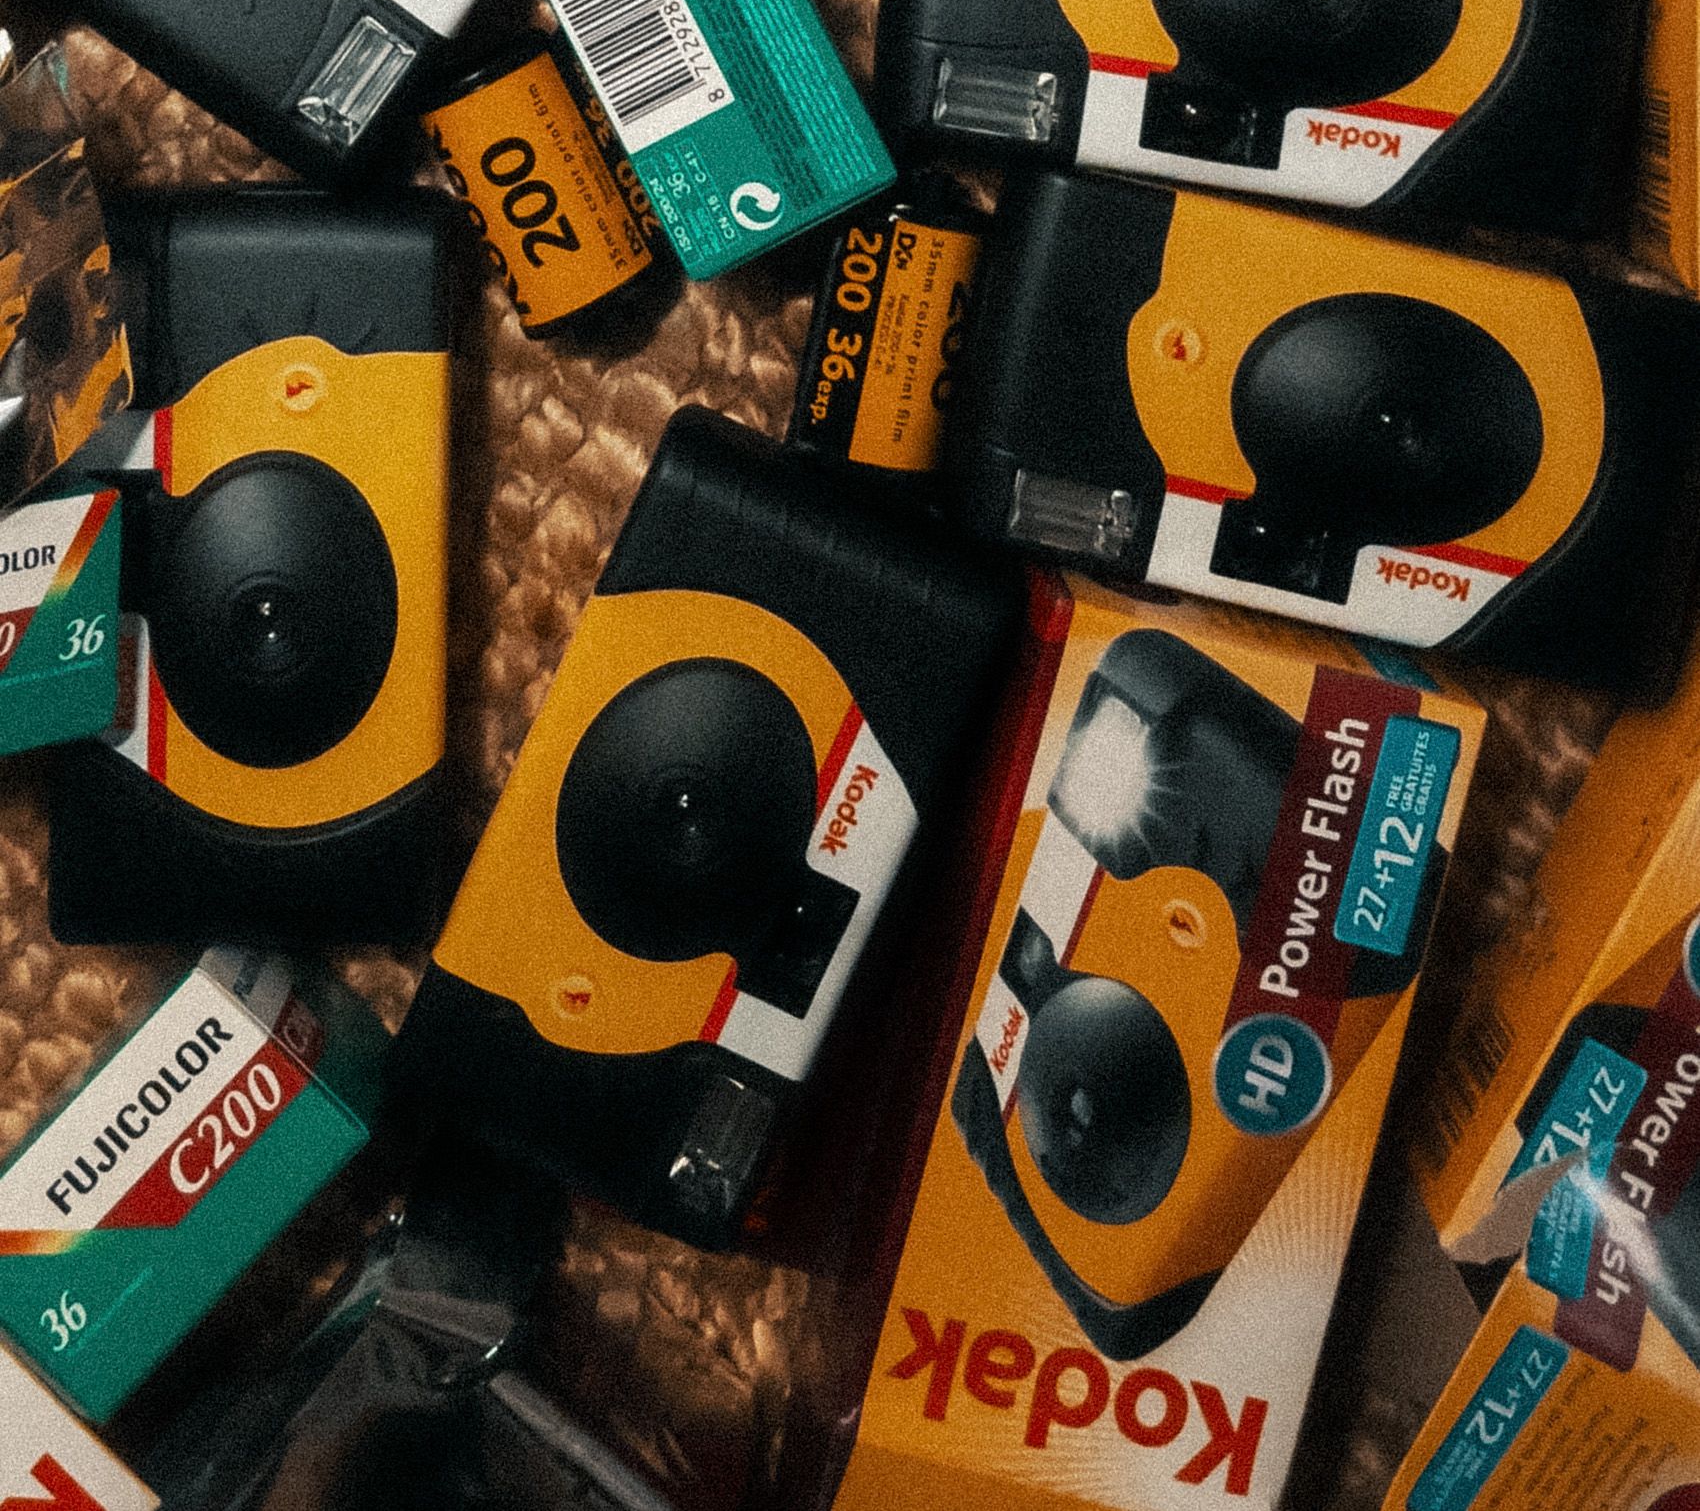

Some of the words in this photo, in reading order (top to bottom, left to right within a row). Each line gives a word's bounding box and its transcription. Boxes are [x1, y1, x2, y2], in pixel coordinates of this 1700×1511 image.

[522, 82, 549, 118] film
[706, 88, 726, 104] 8
[543, 120, 575, 164] print
[1307, 115, 1402, 159] Kodak
[480, 136, 583, 267] 200
[566, 167, 598, 215] color
[664, 169, 693, 200] 36
[591, 215, 627, 271] 35mm
[671, 223, 694, 253] ISO
[921, 237, 944, 294] 35mm
[836, 227, 883, 312] 200
[910, 300, 931, 349] color
[897, 354, 919, 401] print
[891, 408, 911, 444] film
[1376, 555, 1472, 602] Kodak
[54, 613, 110, 661] 36
[1384, 773, 1404, 808] FREE
[1397, 730, 1432, 812] GRATUITES
[1412, 762, 1438, 816] GRATIS
[819, 764, 880, 858] Kodak
[1259, 850, 1332, 999] Power
[1301, 716, 1372, 842] Flash
[1353, 815, 1424, 932] 27+12
[989, 1005, 1026, 1074] Kodak
[1238, 1031, 1298, 1117] HD
[45, 1015, 235, 1216] FUJICOLOR
[168, 1063, 283, 1197] C200
[1630, 1053, 1700, 1168] ower
[41, 1290, 87, 1352] 36
[886, 1306, 1270, 1499] Kodak
[1466, 1348, 1554, 1445] 27+12
